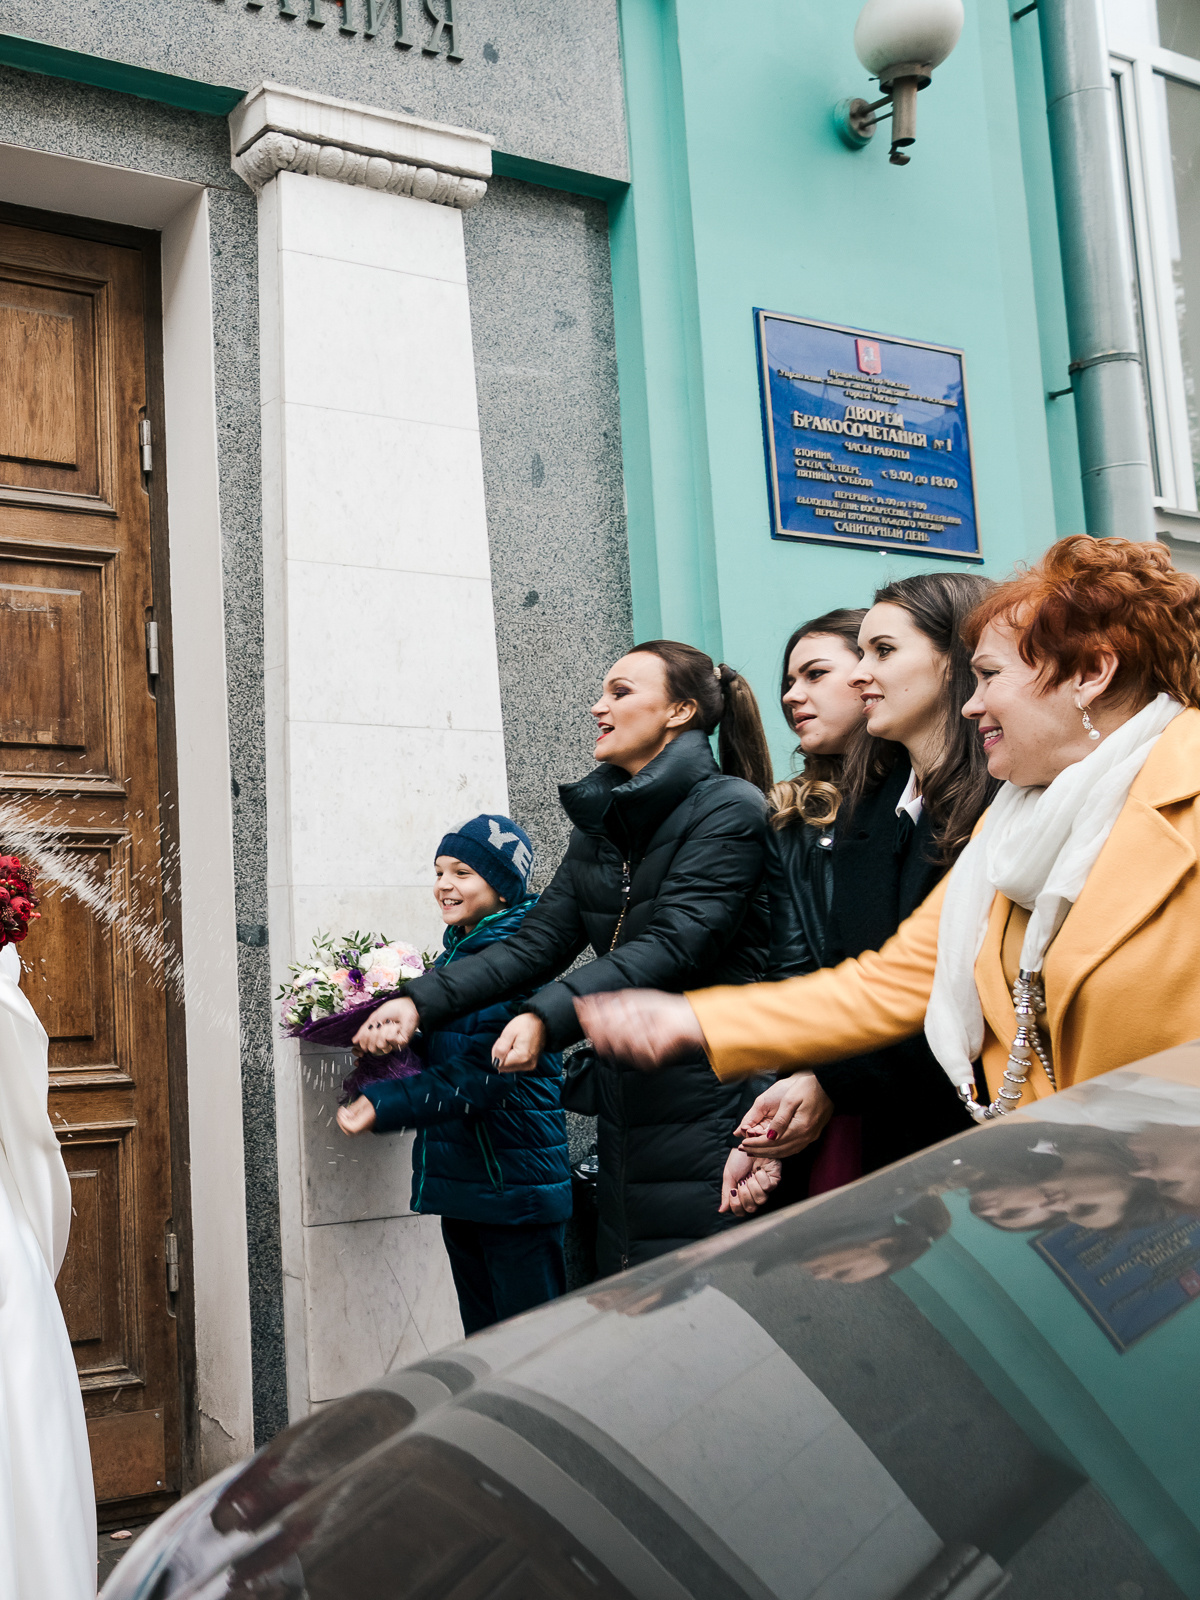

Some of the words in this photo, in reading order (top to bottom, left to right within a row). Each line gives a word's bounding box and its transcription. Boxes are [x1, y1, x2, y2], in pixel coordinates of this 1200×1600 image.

[844, 405, 905, 429] ДВОРЕЦ
[793, 411, 927, 446] БРАКОСОЧЕТАНИЯ
[845, 442, 871, 453] ЧАСЫ
[874, 447, 909, 460] РАБОТЫ
[839, 475, 873, 487] СУББОТА
[890, 470, 913, 482] 9.00
[931, 476, 957, 489] 18.00
[797, 496, 839, 508] ВЫХОДНЫЕ
[835, 491, 868, 502] ПЕРЕРЫВ
[816, 507, 845, 519] ПЕРВЫЙ
[848, 513, 879, 523] ВТОРНИК
[882, 517, 916, 528] КАЖДОГО
[835, 520, 902, 538] САНИТАРНЫЙ
[904, 530, 930, 543] ДЕНЬ
